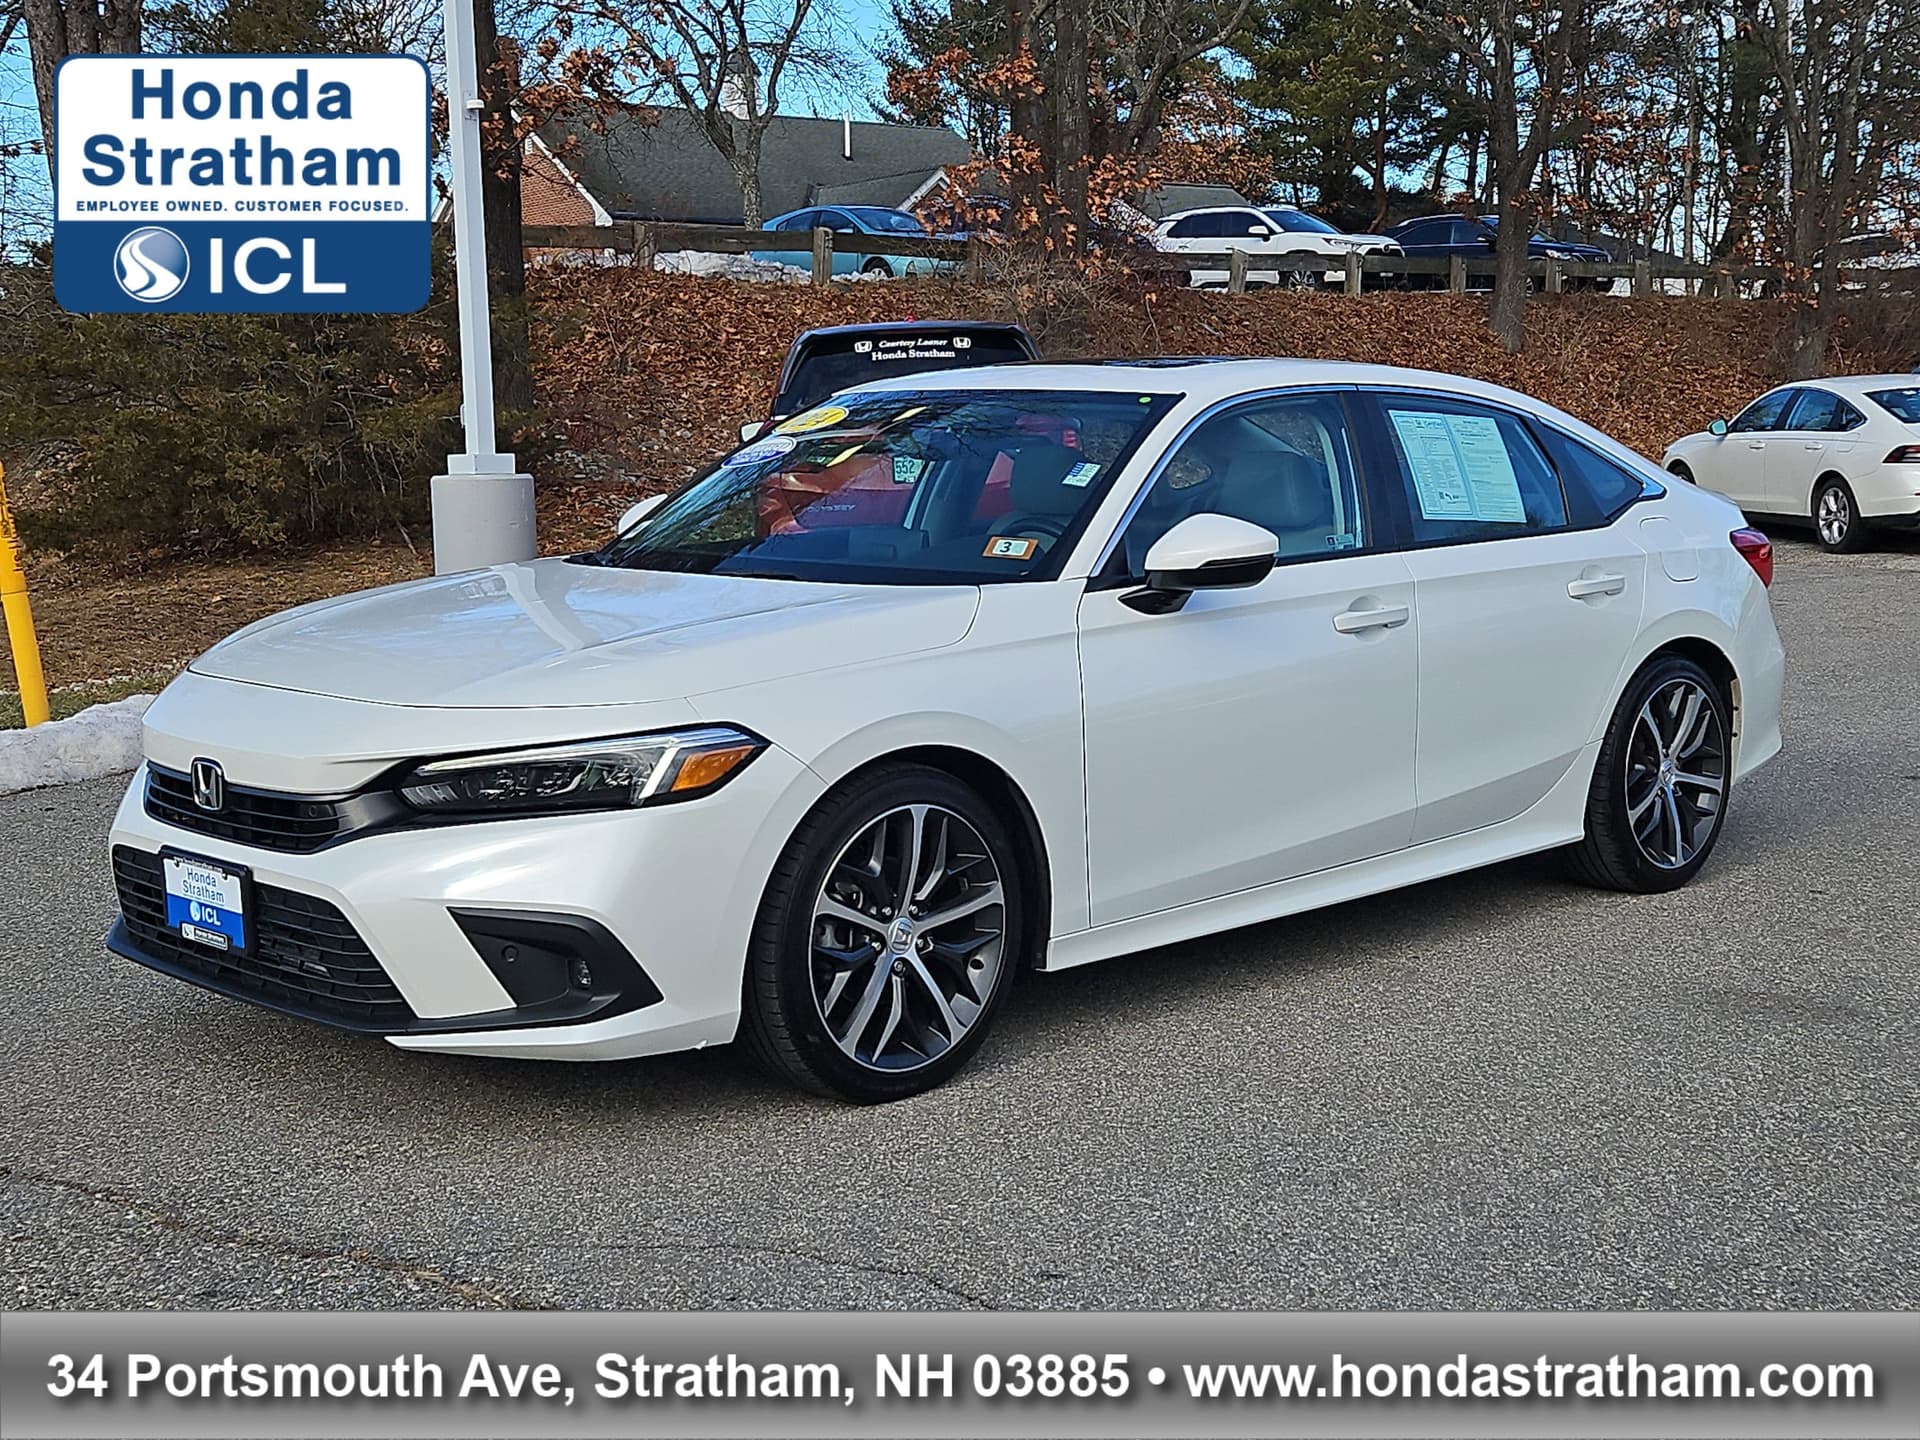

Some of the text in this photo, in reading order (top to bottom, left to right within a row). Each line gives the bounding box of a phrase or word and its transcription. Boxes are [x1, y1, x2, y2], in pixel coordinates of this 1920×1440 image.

[872, 348, 956, 361] Honda Stratham
[999, 541, 1012, 553] 3
[187, 867, 216, 888] Honda
[183, 880, 225, 903] Stratham
[201, 905, 222, 926] ICL
